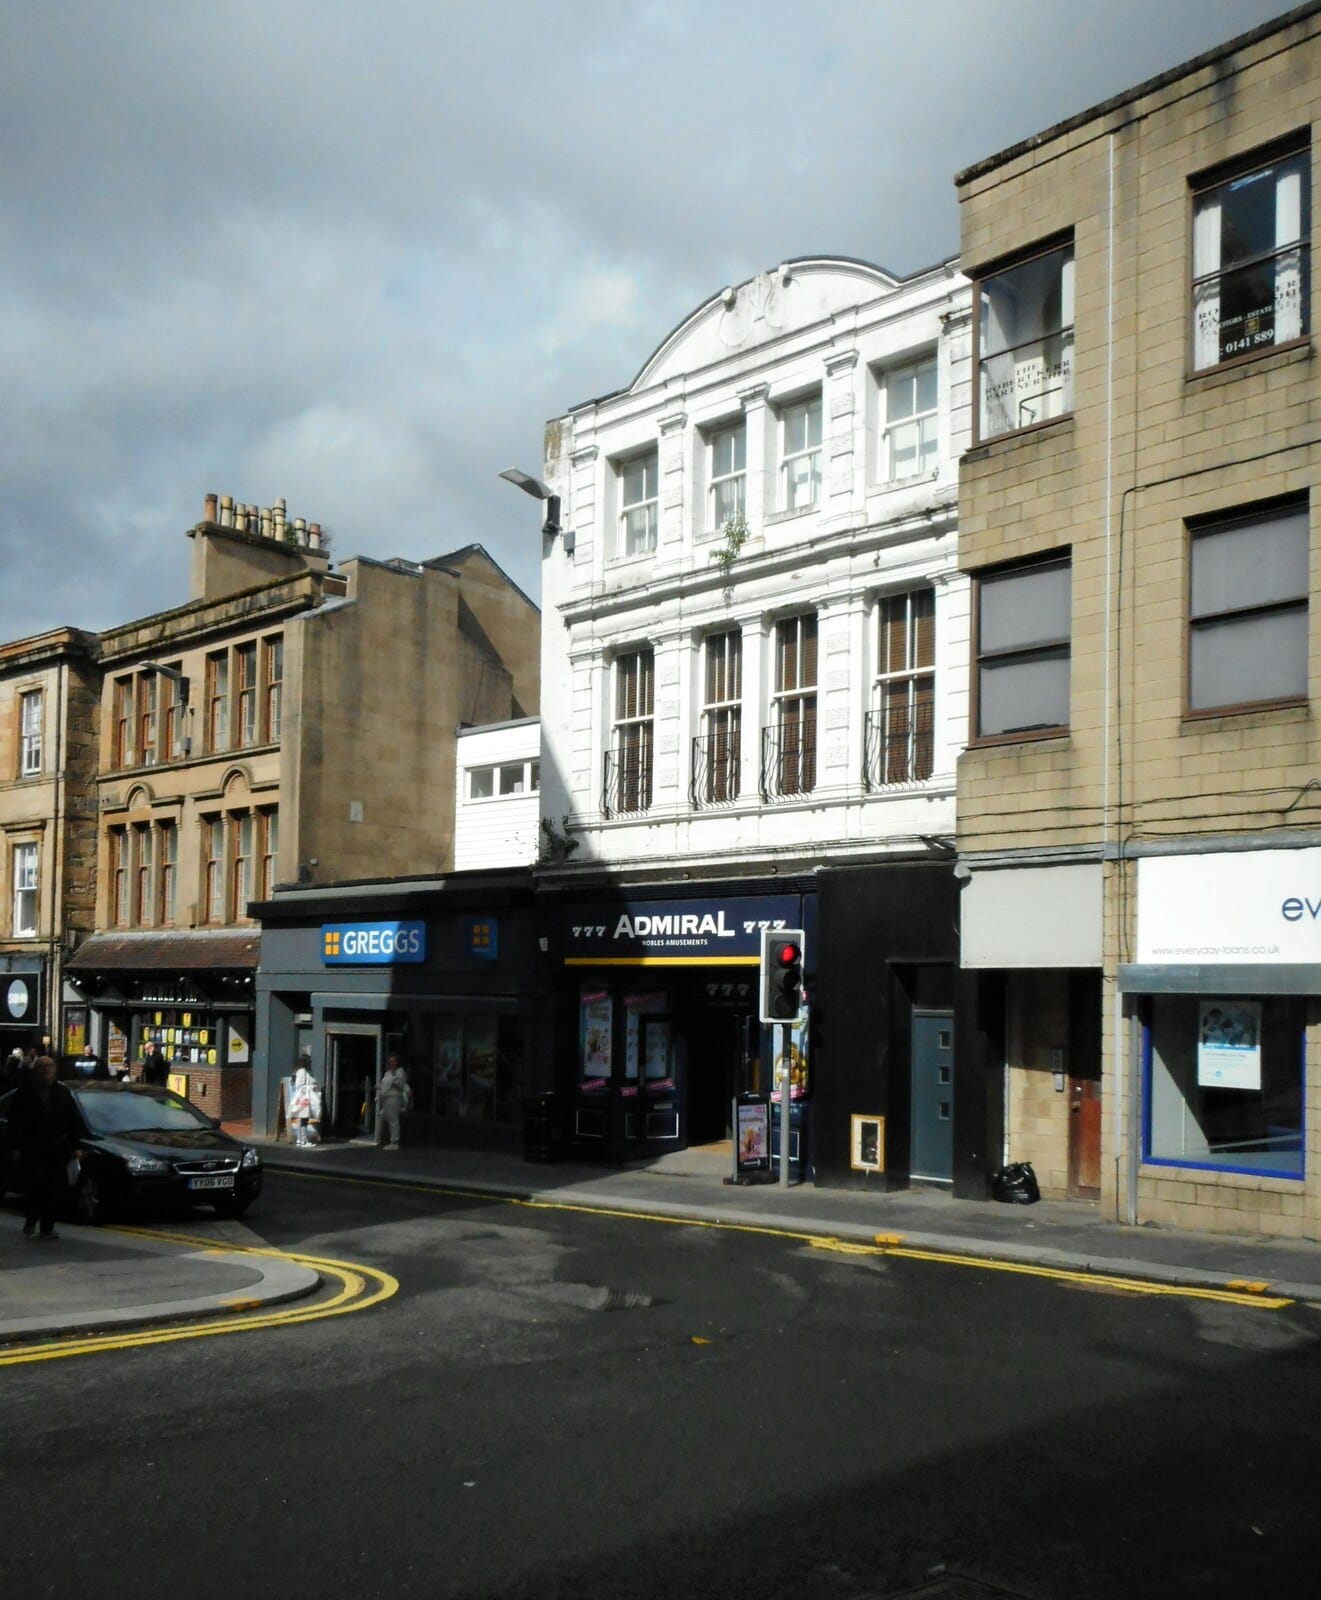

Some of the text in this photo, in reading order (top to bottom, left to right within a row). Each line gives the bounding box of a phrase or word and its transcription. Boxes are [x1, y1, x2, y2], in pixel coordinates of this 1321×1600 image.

[1247, 304, 1273, 318] ESTATE
[1225, 337, 1251, 353] 0141
[1253, 329, 1274, 344] 889
[572, 926, 606, 937] 777
[613, 910, 735, 939] ADMIRAL
[343, 929, 420, 955] GREGGS
[641, 938, 708, 947] NOBLES AMUSEMENTS
[1152, 945, 1280, 956] www.everyday-loans.co.uk
